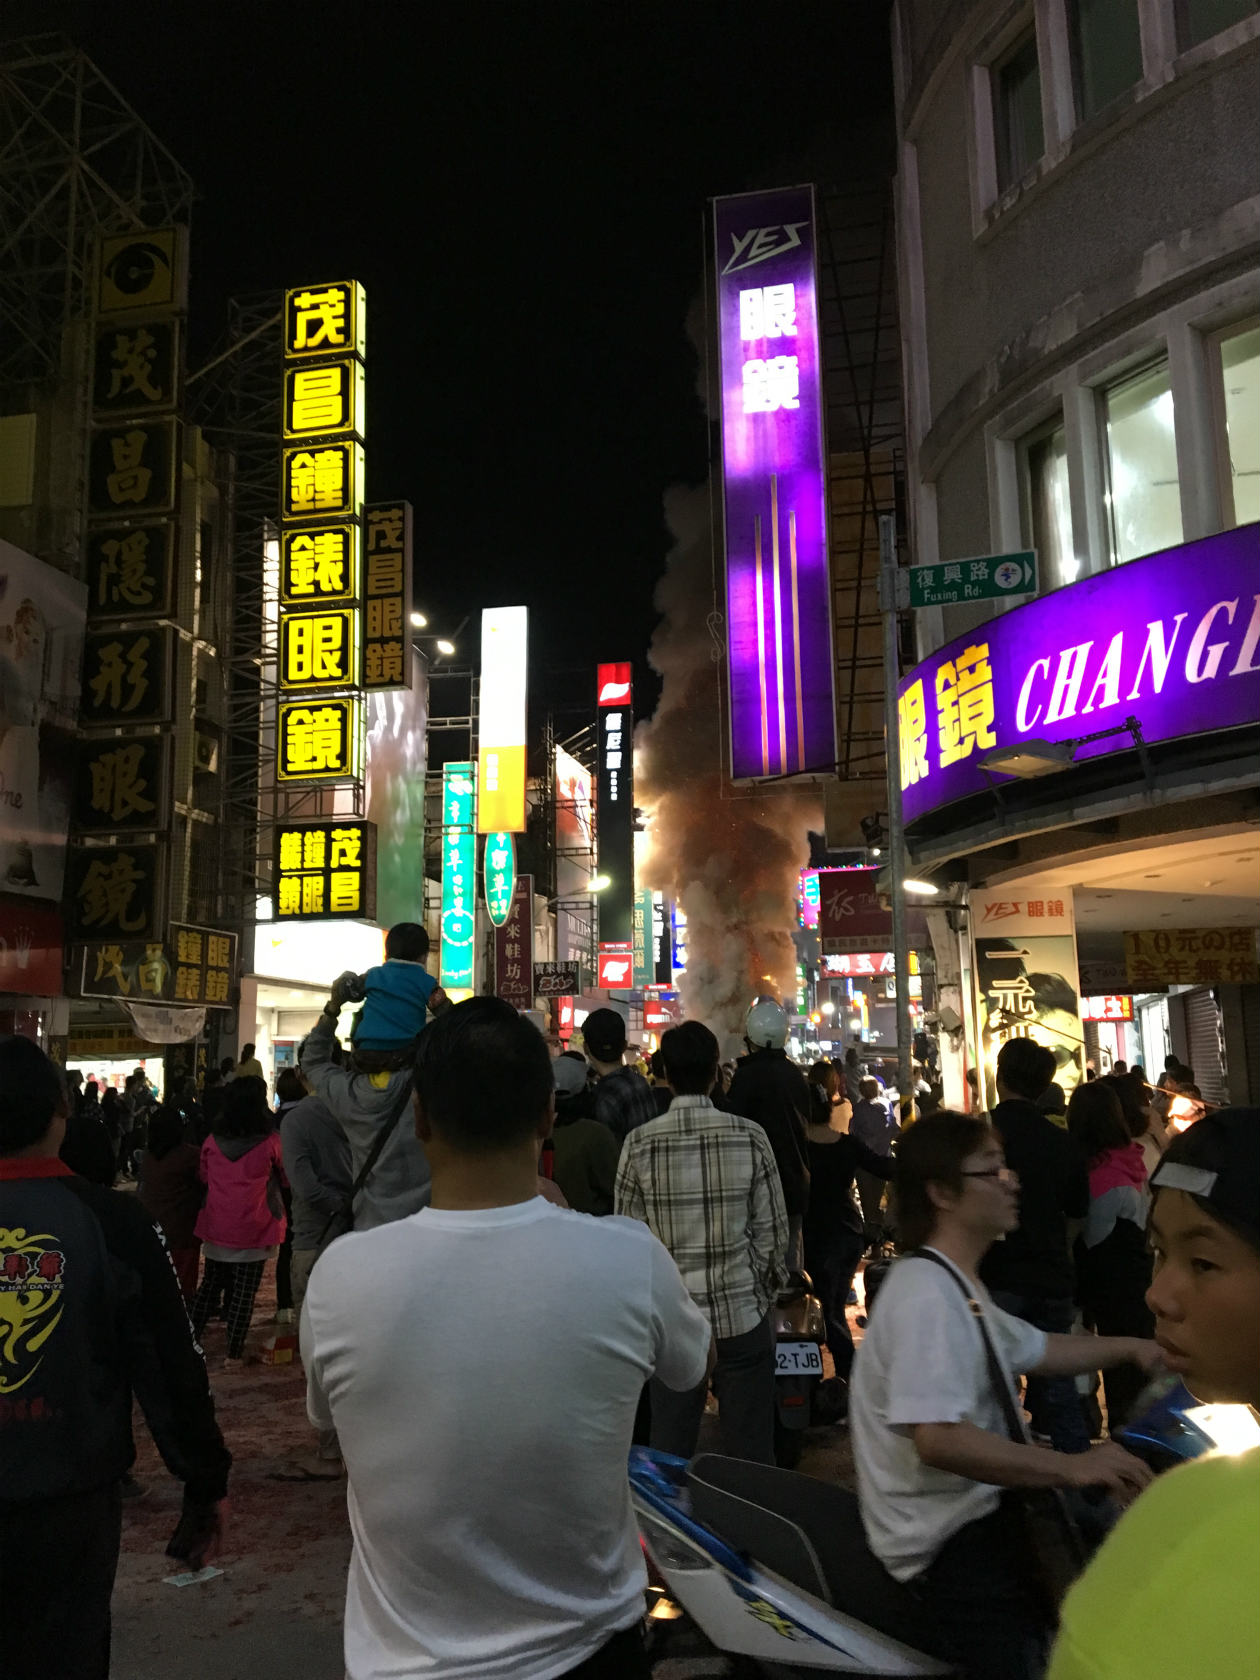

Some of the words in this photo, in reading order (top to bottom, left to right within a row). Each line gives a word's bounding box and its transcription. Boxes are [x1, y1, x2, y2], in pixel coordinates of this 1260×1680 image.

[721, 221, 810, 275] YES
[739, 283, 800, 414] 眼鏡
[286, 288, 345, 772] 茂昌鐘錶眼鏡
[916, 561, 989, 588] 復興路
[365, 509, 404, 683] 茂昌眼鏡
[924, 589, 958, 602] Fuxing
[899, 643, 997, 791] 眼鏡
[981, 901, 1023, 923] YES
[1027, 900, 1064, 917] 眼鏡
[1131, 957, 1253, 983] 全年無休
